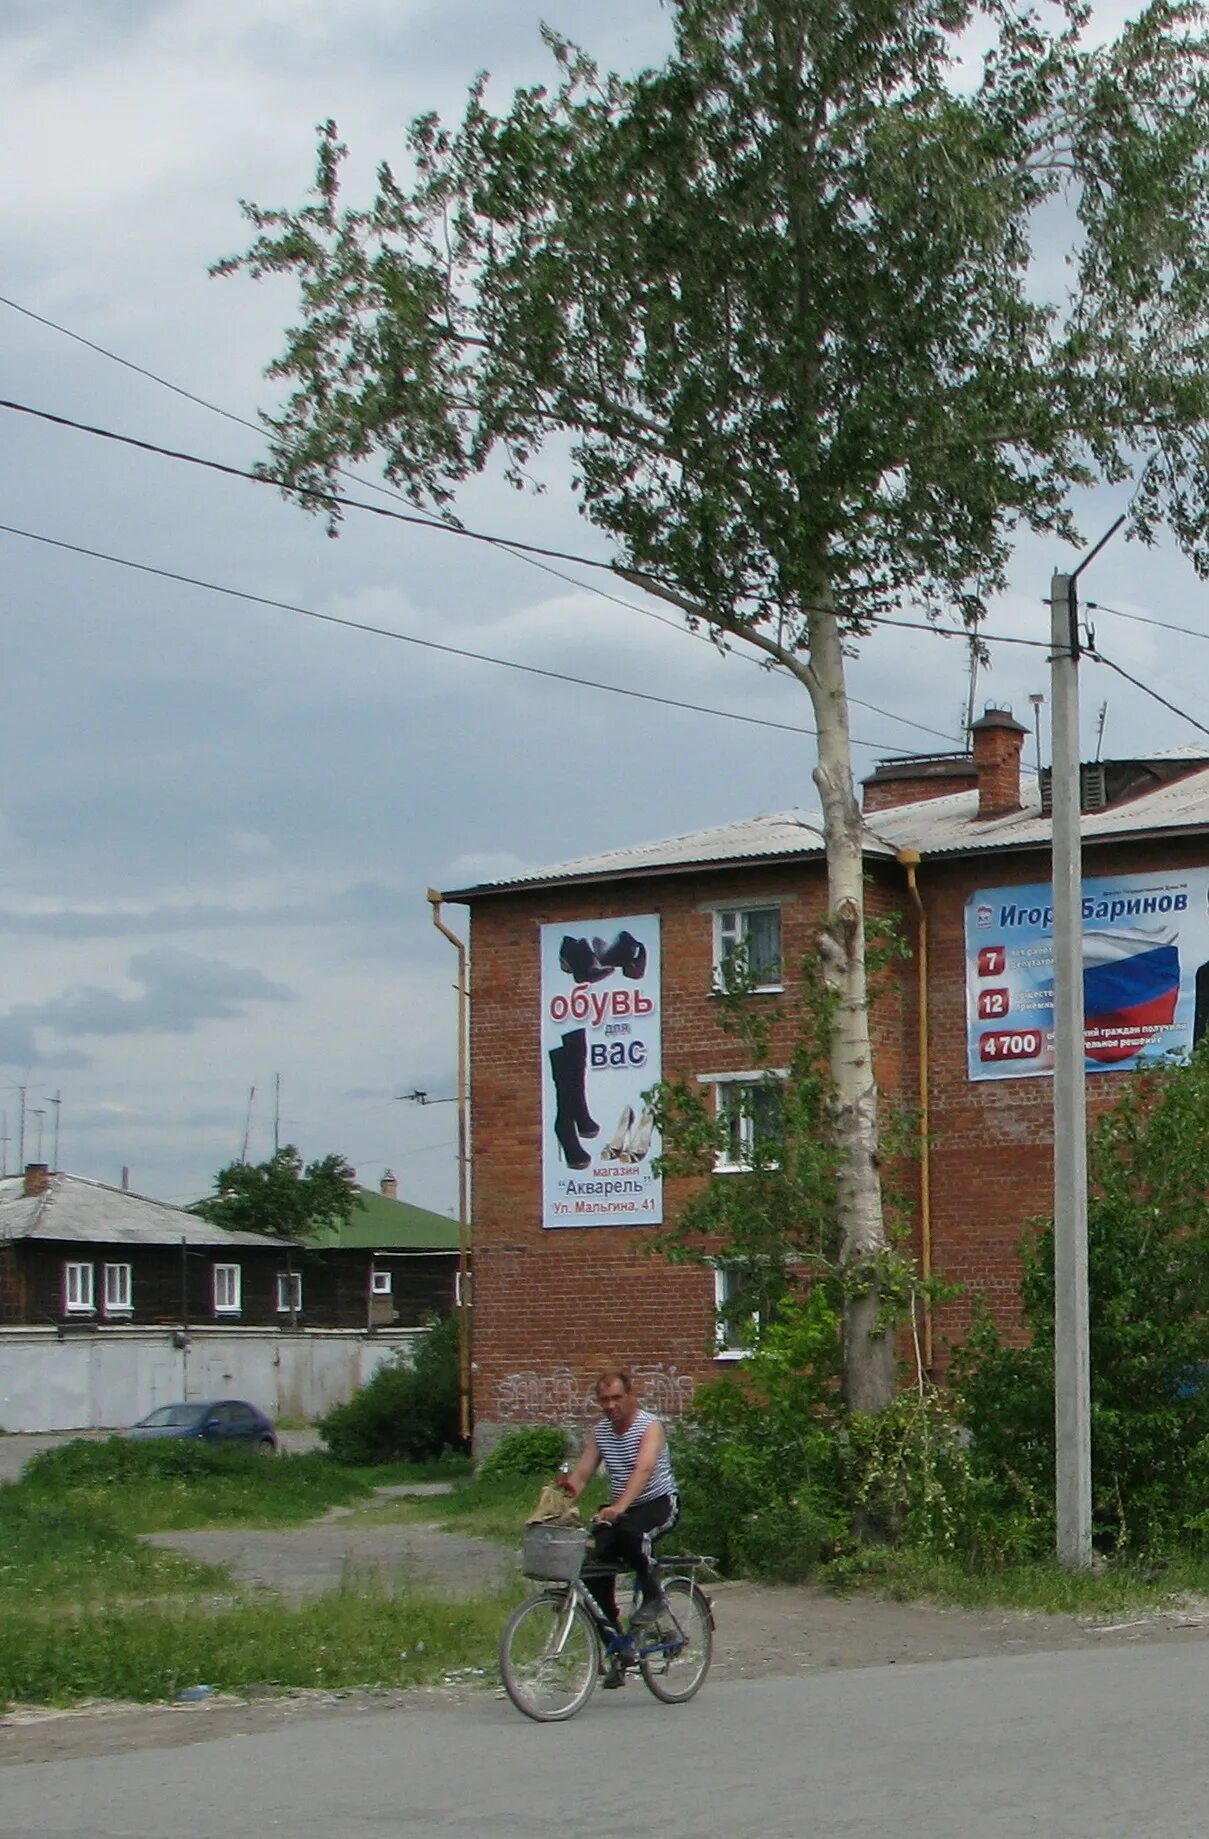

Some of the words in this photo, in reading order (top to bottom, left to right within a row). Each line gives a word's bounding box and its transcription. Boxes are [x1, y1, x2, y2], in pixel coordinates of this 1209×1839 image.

[1000, 904, 1054, 928] Игор
[1081, 893, 1188, 922] Баринов
[985, 952, 998, 971] 7
[549, 984, 654, 1027] обувь
[983, 994, 1003, 1014] 12
[604, 1023, 631, 1037] для
[1101, 1026, 1140, 1037] граждан
[590, 1040, 646, 1067] вас
[593, 1166, 639, 1177] магазин
[642, 1198, 656, 1211] 41
